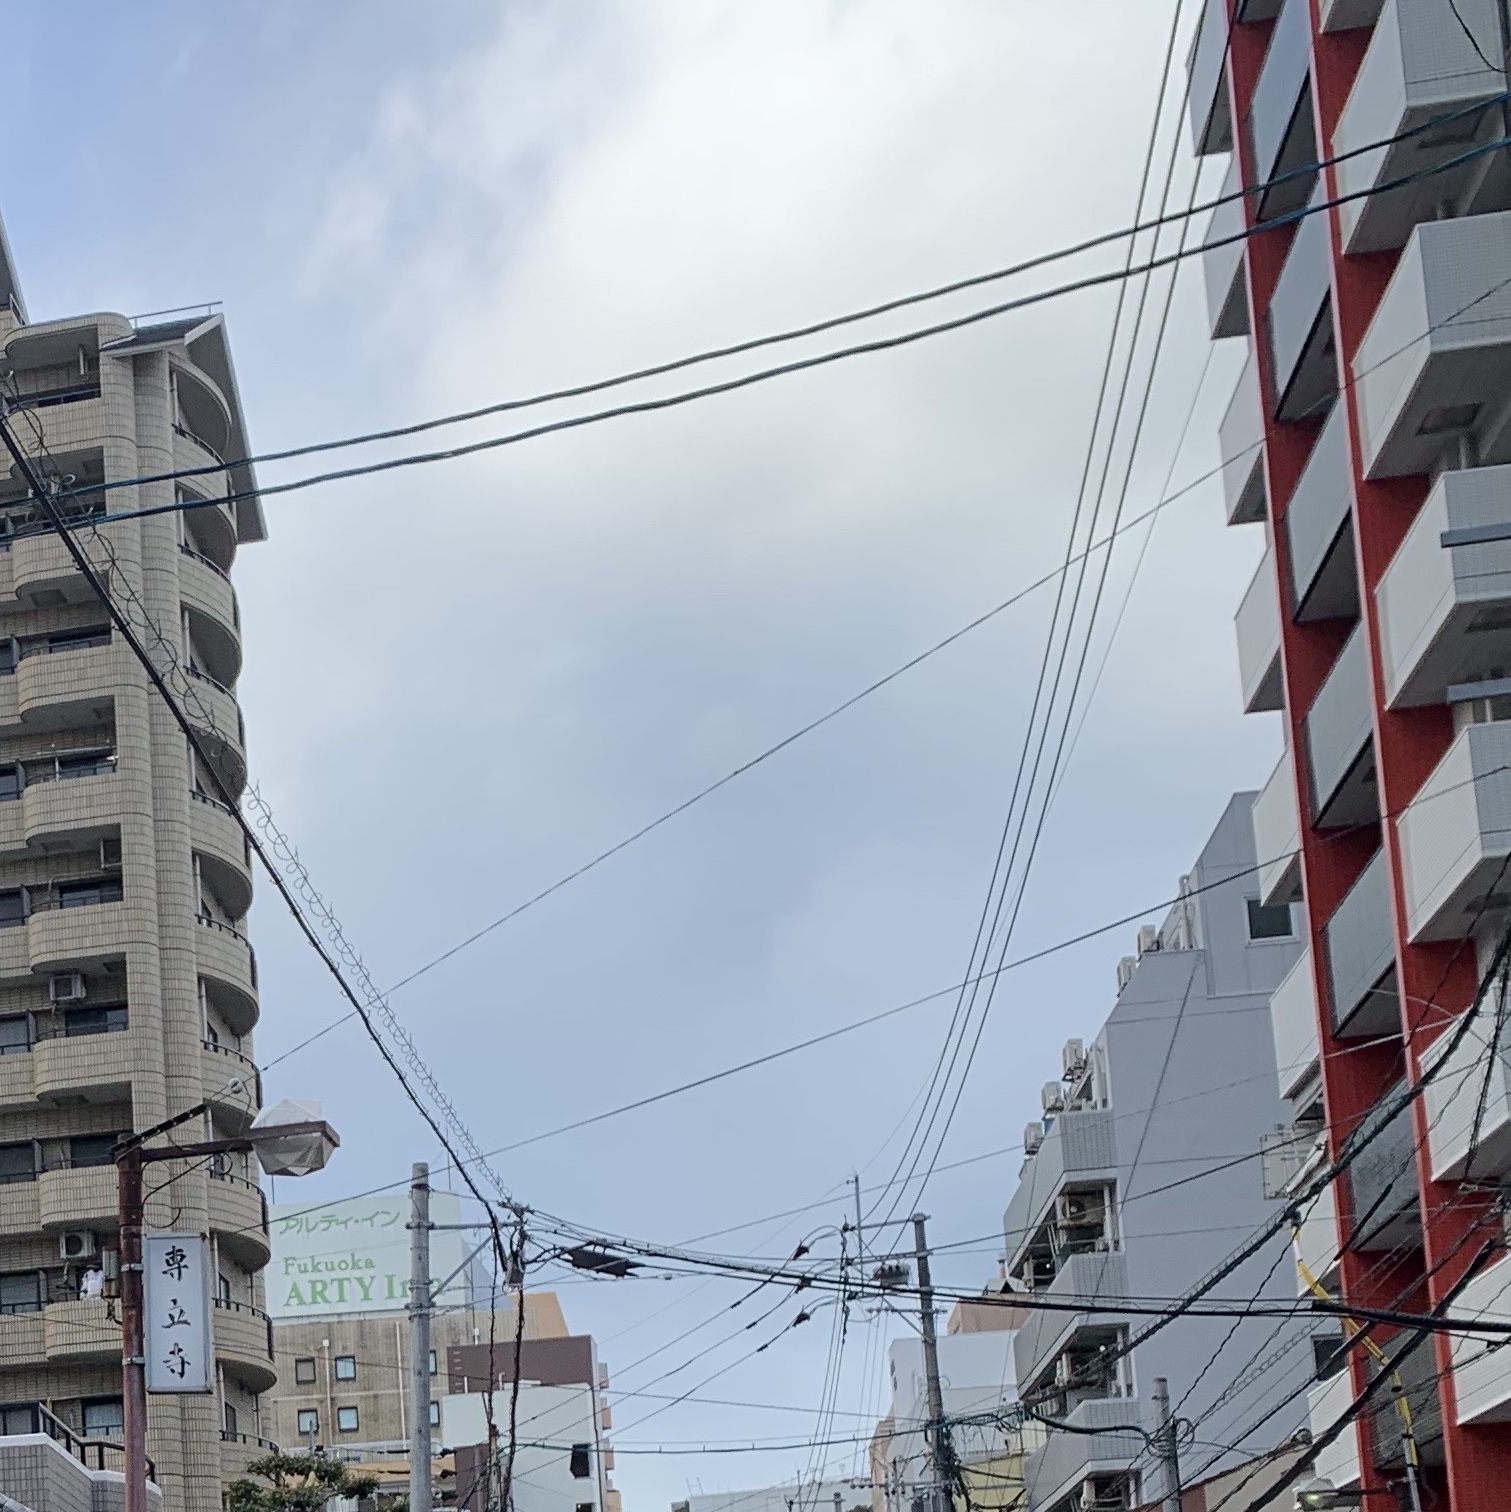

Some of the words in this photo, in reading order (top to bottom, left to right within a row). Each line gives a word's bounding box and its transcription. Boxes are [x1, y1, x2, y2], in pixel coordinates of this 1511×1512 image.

[283, 1252, 376, 1276] Fukuoka
[283, 1275, 376, 1307] ARTY
[161, 1245, 192, 1379] 専立寺
